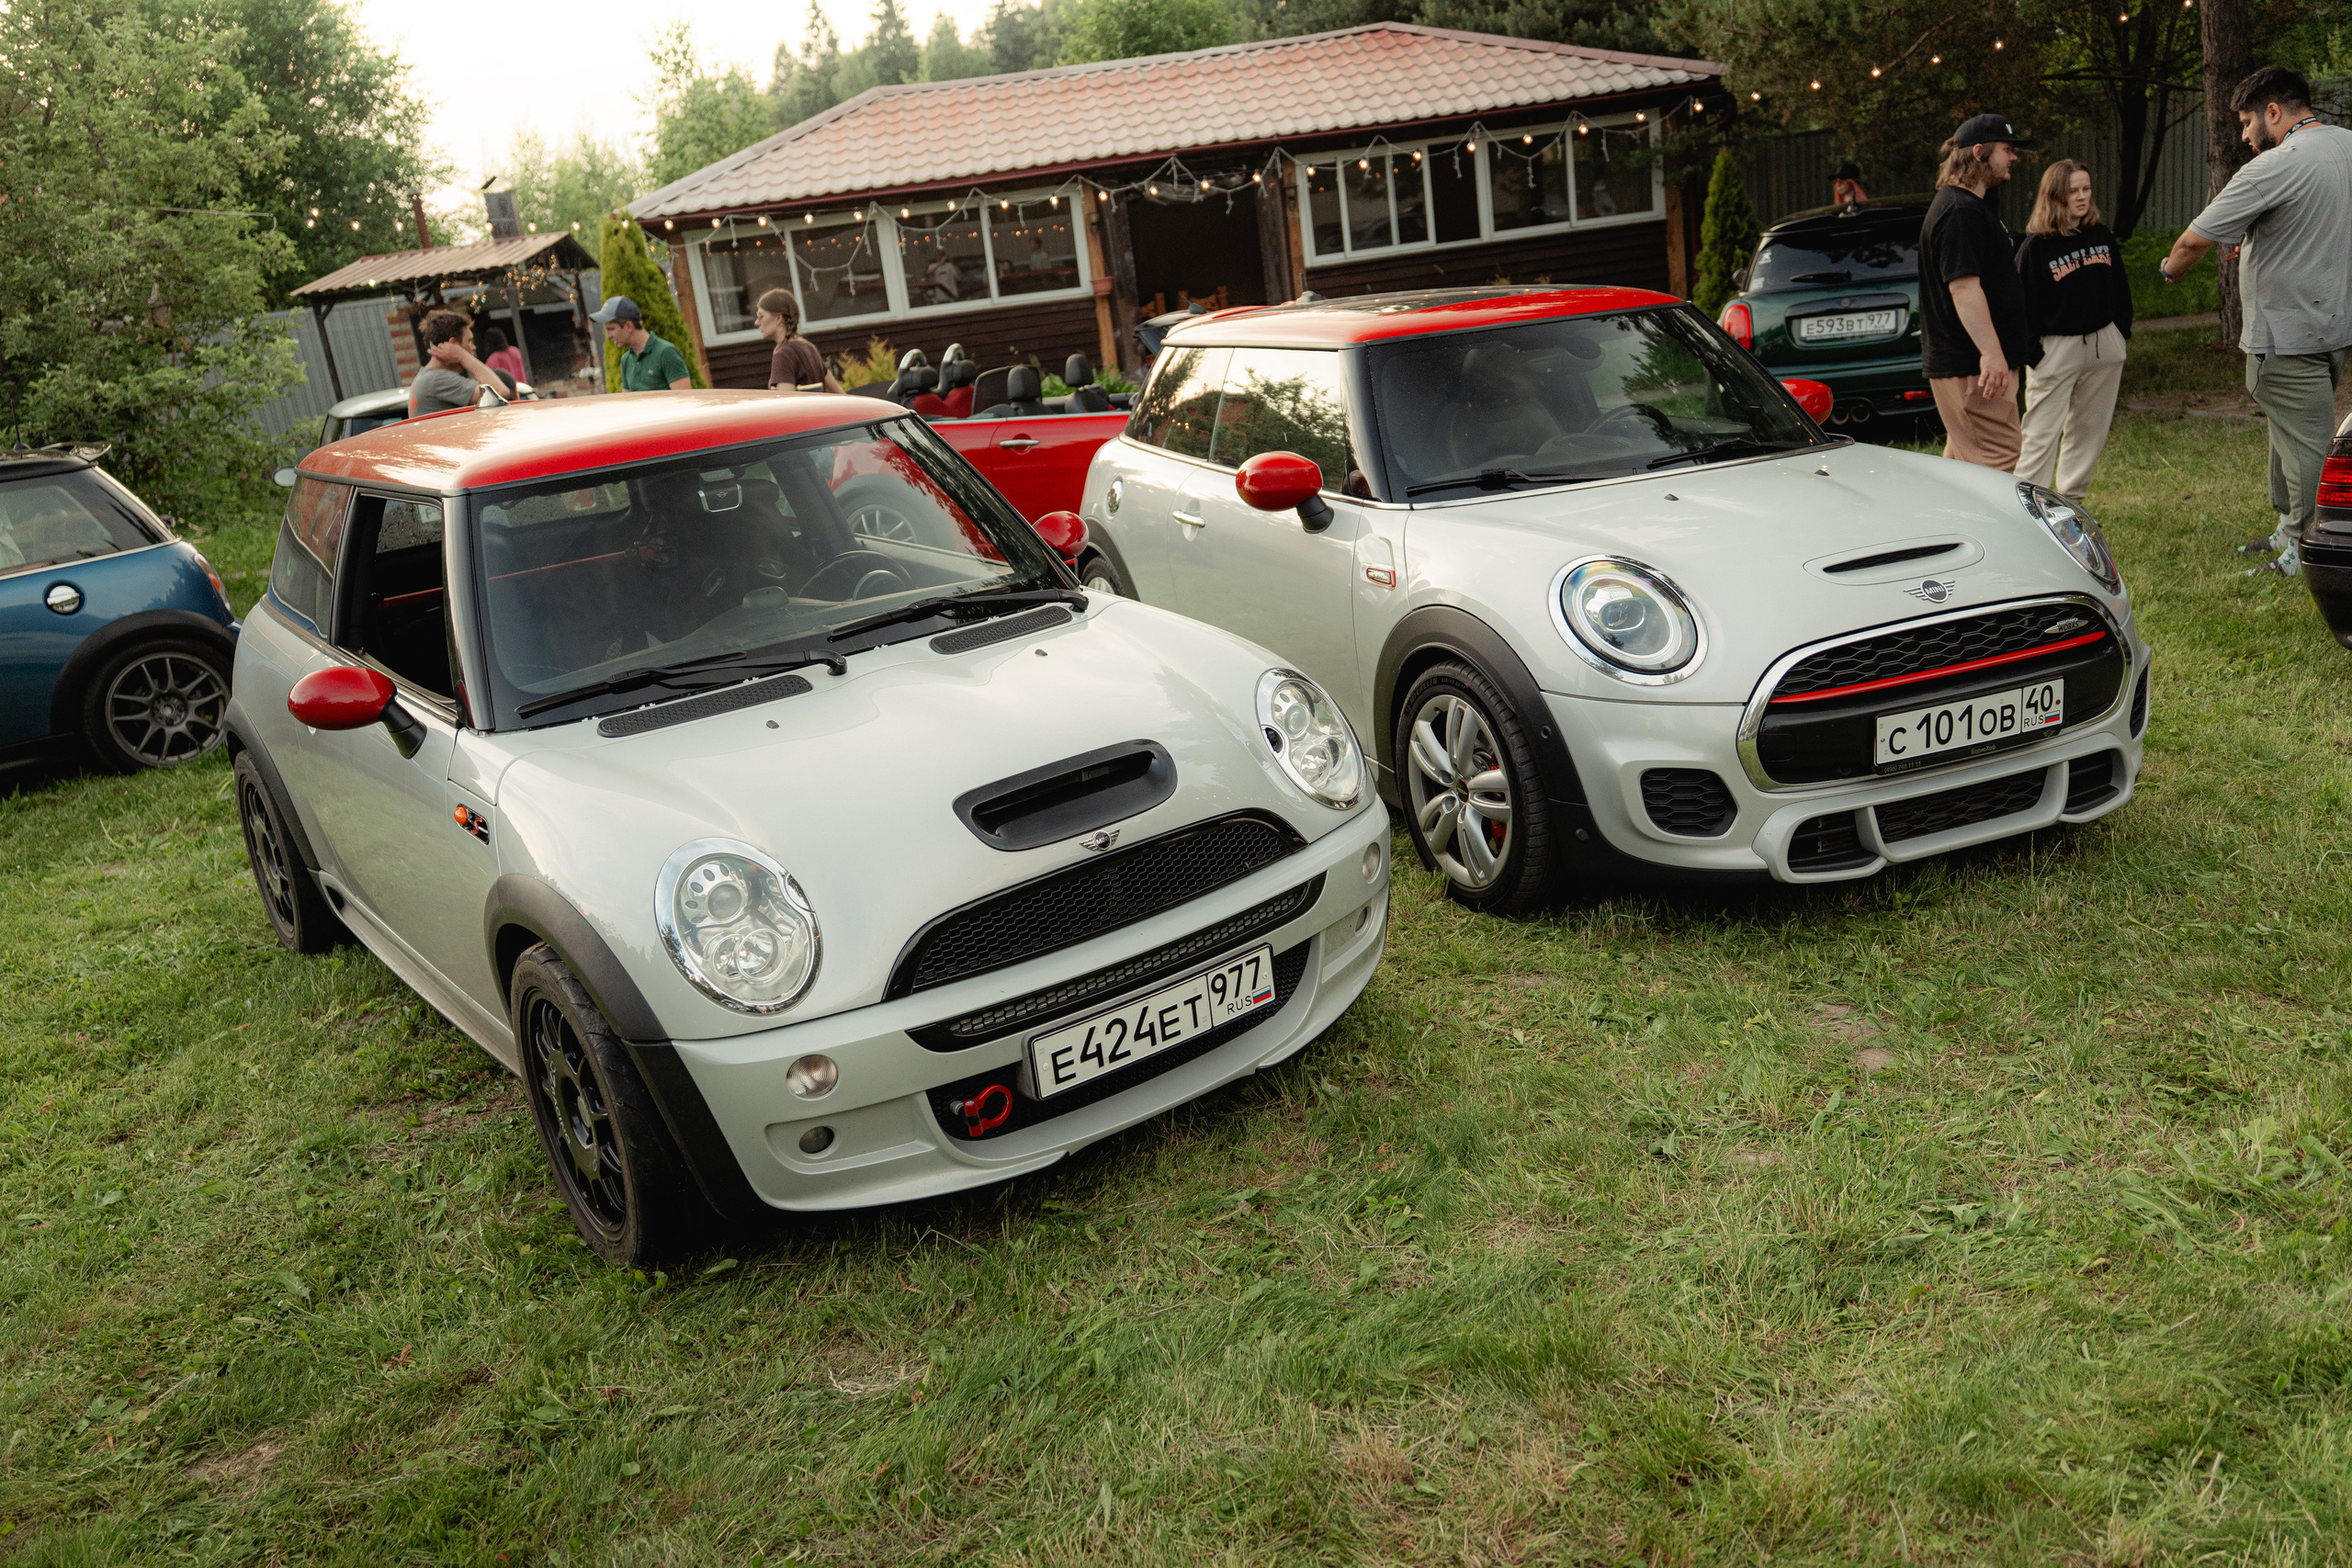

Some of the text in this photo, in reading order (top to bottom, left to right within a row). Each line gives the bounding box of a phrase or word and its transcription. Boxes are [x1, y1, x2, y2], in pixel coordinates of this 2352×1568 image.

[2049, 251, 2080, 282] SALT
[1868, 312, 1891, 325] 977
[1925, 585, 1945, 594] MINI
[1409, 678, 1438, 705] MICHELIN
[2026, 684, 2054, 715] 40
[2023, 715, 2044, 728] RUS
[1227, 996, 1252, 1015] RUS
[1050, 955, 1261, 1085] E424ET 977
